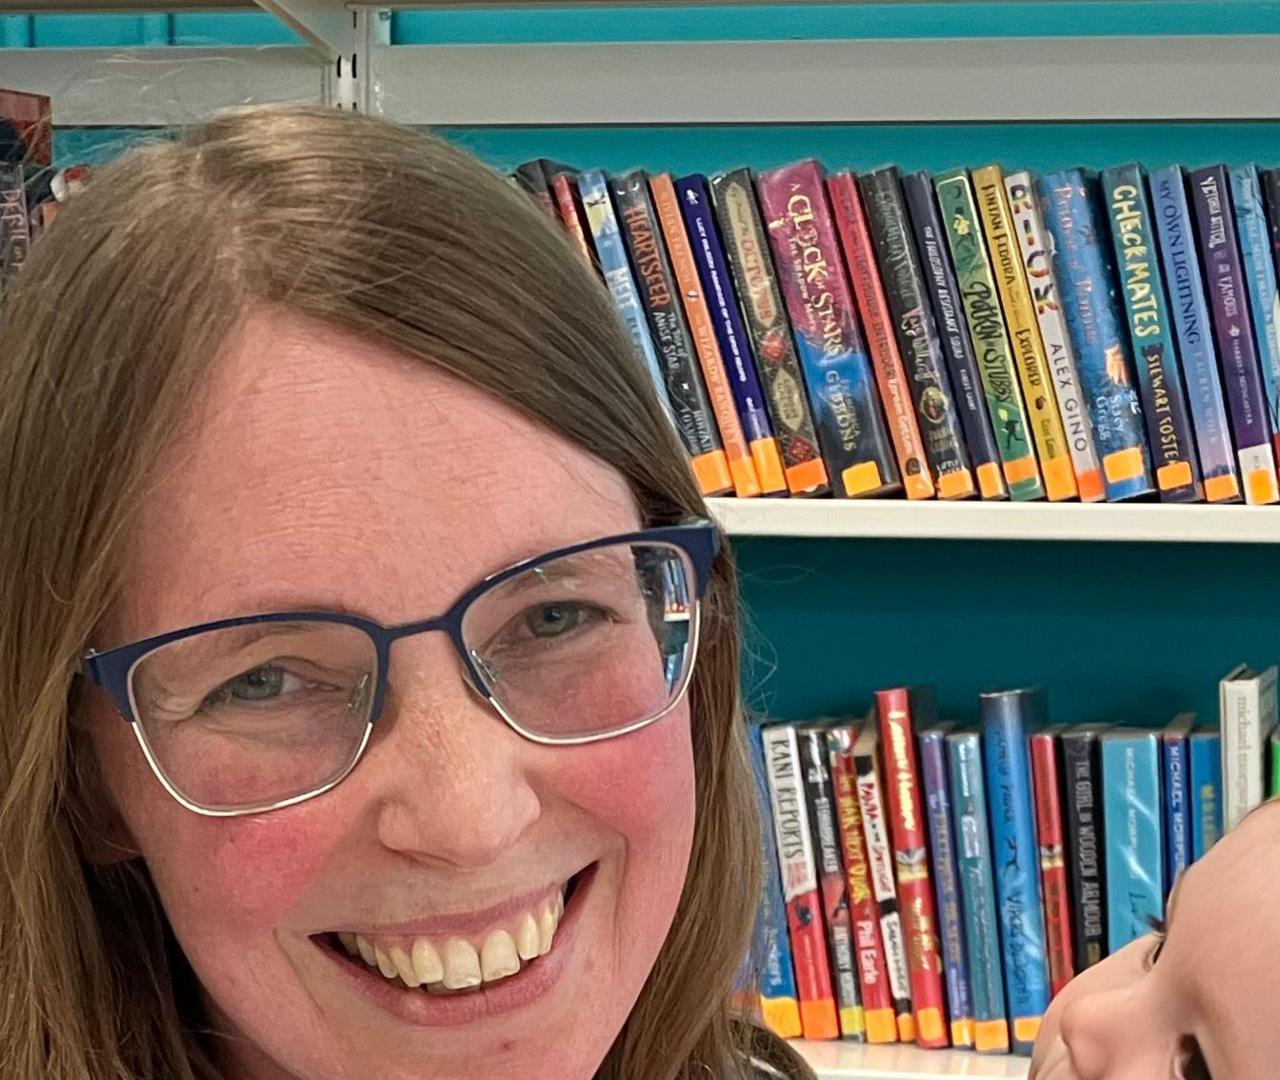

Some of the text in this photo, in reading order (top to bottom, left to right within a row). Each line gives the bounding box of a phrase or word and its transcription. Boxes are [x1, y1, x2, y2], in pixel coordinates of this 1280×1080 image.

[623, 206, 670, 309] HEARTSEER
[980, 184, 1041, 386] FINTAN FEDORA EXPLORER
[1156, 179, 1201, 345] MY OWN LIGHTNING
[811, 291, 843, 356] STARS
[983, 348, 1016, 402] STUBBS
[1050, 343, 1089, 453] ALEX GINO
[1147, 354, 1168, 414] STEWART
[771, 739, 804, 861] RANI REPORTS
[1074, 760, 1089, 778] THE
[1169, 746, 1183, 808] MICHAEL
[1079, 826, 1095, 877] WOODEN
[857, 921, 879, 984] Phil Earle
